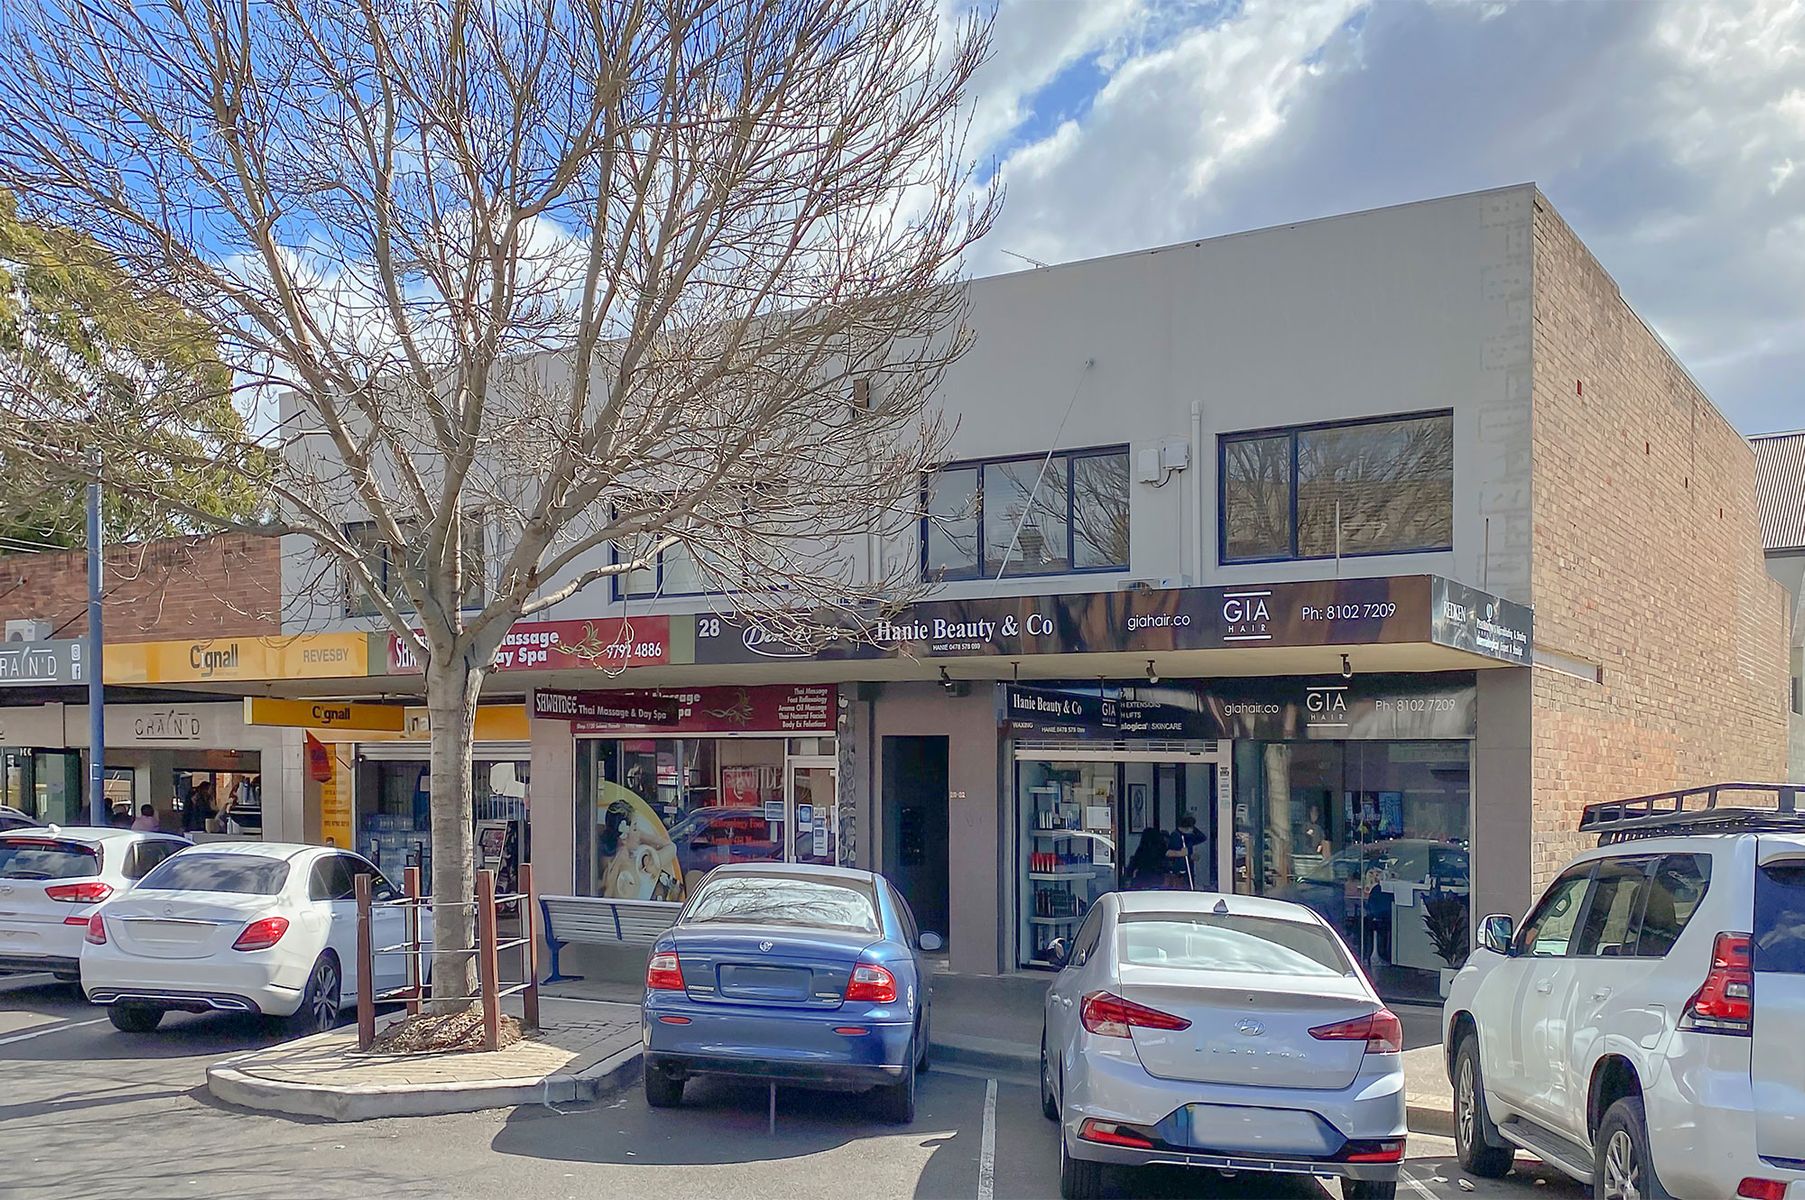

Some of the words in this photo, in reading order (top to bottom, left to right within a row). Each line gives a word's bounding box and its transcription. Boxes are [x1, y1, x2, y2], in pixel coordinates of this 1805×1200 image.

[1223, 599, 1270, 622] GIA
[1301, 606, 1323, 621] Ph:
[1326, 604, 1360, 620] 8102
[1362, 603, 1396, 618] 7209
[698, 619, 720, 637] 28
[876, 619, 929, 642] Hanie
[932, 617, 997, 643] Beauty
[1001, 614, 1018, 637] &
[1026, 613, 1054, 635] Co
[1127, 614, 1191, 631] giahair.co
[1228, 624, 1266, 633] HAIR
[504, 631, 560, 650] assage
[303, 648, 350, 663] REVESBY
[496, 651, 515, 667] ay
[518, 648, 548, 663] Spa
[634, 642, 662, 658] 4886
[1013, 693, 1036, 710] Hanie
[1037, 697, 1061, 716] Beauty
[1063, 700, 1070, 714] &
[1071, 702, 1082, 715] Co
[1102, 703, 1116, 716] GIA
[1307, 693, 1347, 711] GIA
[1375, 700, 1394, 711] Ph:
[1396, 700, 1425, 711] 8102
[1427, 699, 1456, 711] 7209
[578, 704, 595, 716] Thai
[597, 708, 629, 718] Massage
[631, 709, 636, 718] &
[638, 710, 651, 720] Day
[653, 709, 667, 720] Spa
[678, 708, 692, 720] pa
